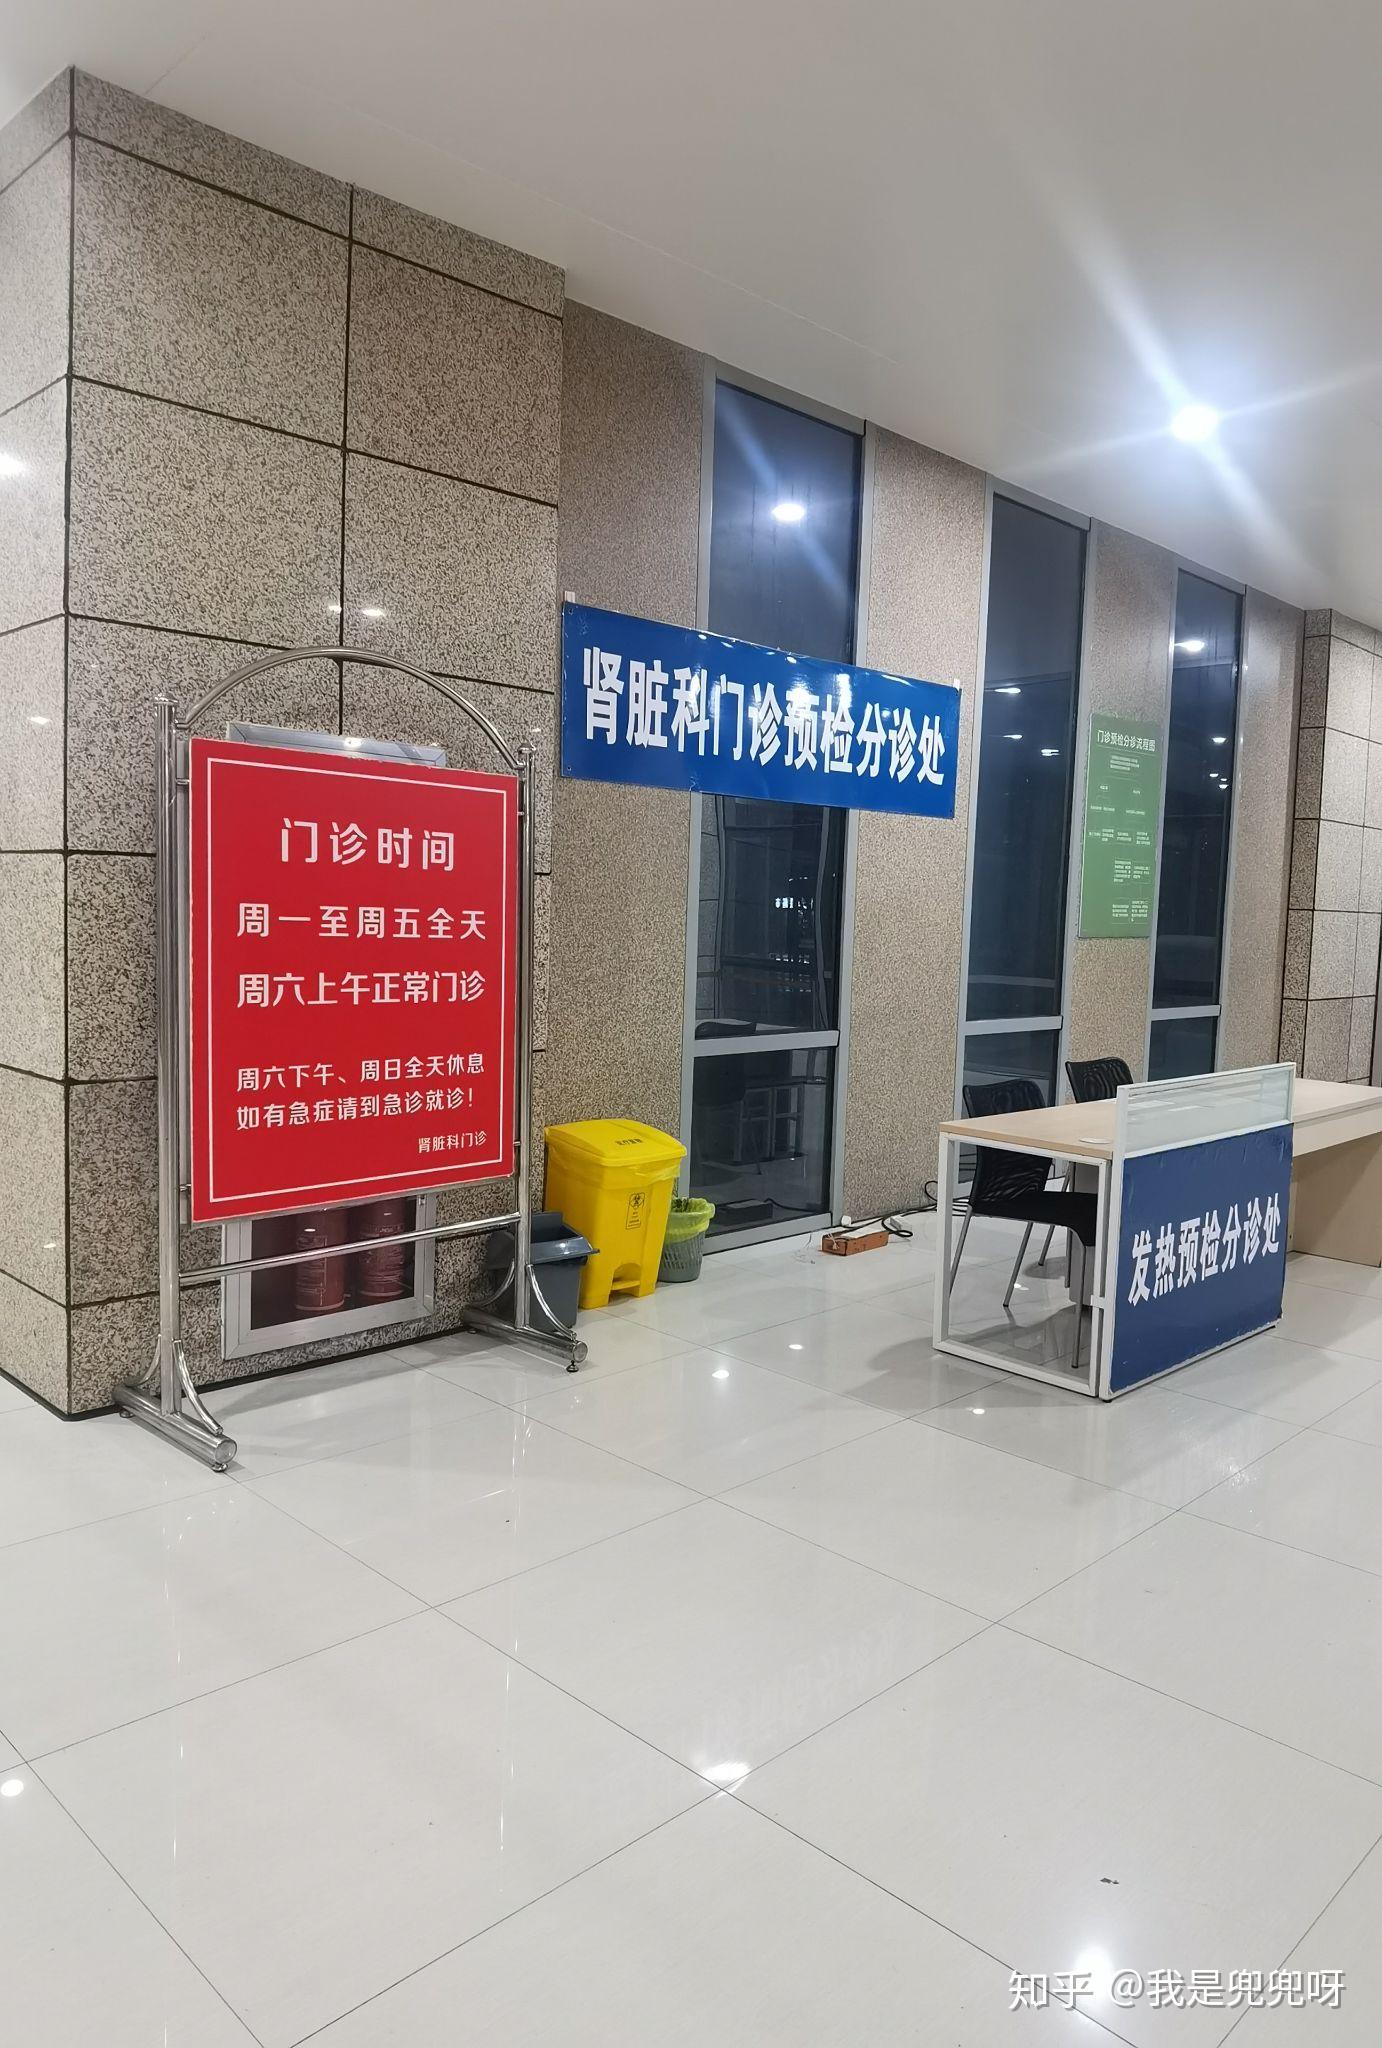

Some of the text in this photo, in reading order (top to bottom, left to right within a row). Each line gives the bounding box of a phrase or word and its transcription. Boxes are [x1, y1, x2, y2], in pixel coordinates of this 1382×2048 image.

[583, 646, 945, 786] 肾脏科门诊预检分诊处
[280, 817, 455, 871] 门诊时间
[237, 902, 487, 941] 周一至周五全天
[237, 969, 487, 1008] 周六上午正常门诊
[418, 1130, 488, 1154] 肾脏科门诊
[1127, 1192, 1281, 1307] 发热预检分诊处
